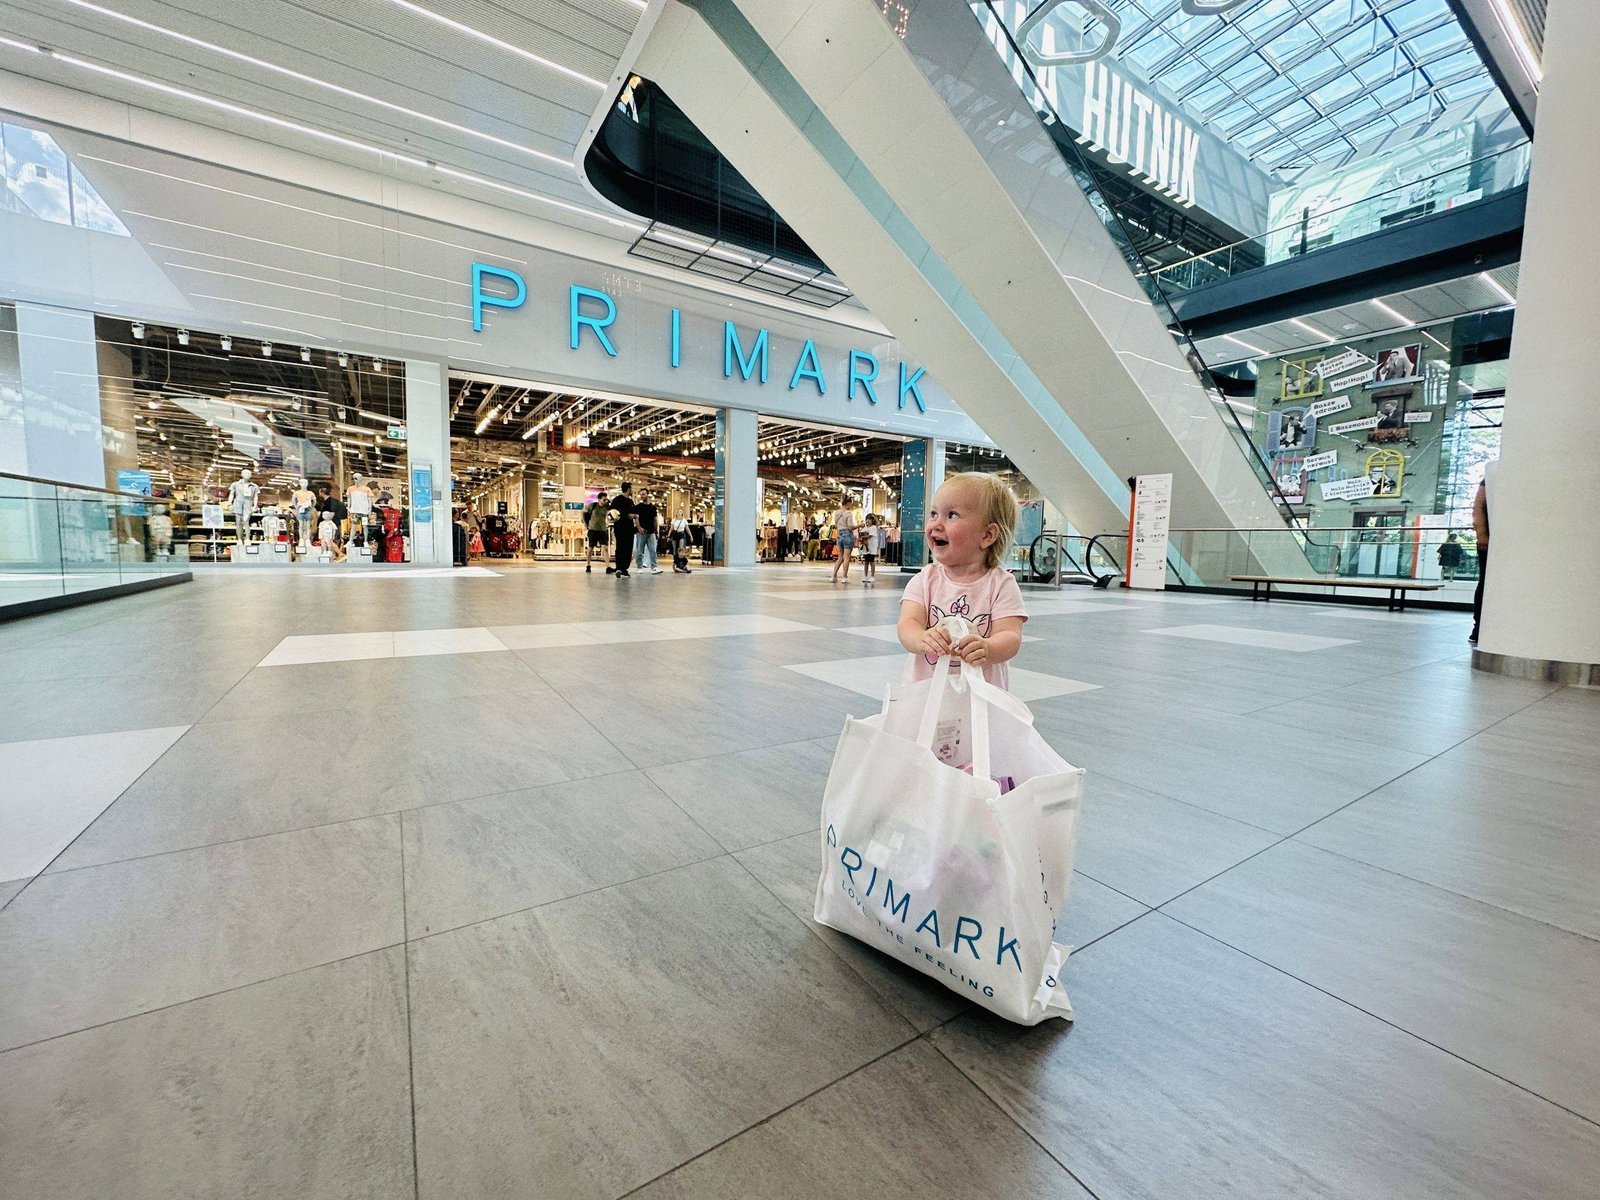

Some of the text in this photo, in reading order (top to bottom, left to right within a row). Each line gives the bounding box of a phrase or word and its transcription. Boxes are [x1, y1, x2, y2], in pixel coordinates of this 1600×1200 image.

[1080, 60, 1200, 209] HUTNIK
[471, 261, 927, 413] PRIMARK
[1333, 373, 1368, 388] Hop!Hop!
[1314, 402, 1349, 415] zdrowie!
[826, 823, 1023, 974] PRIMARK
[876, 918, 904, 945] THE
[914, 946, 995, 998] FEELING
